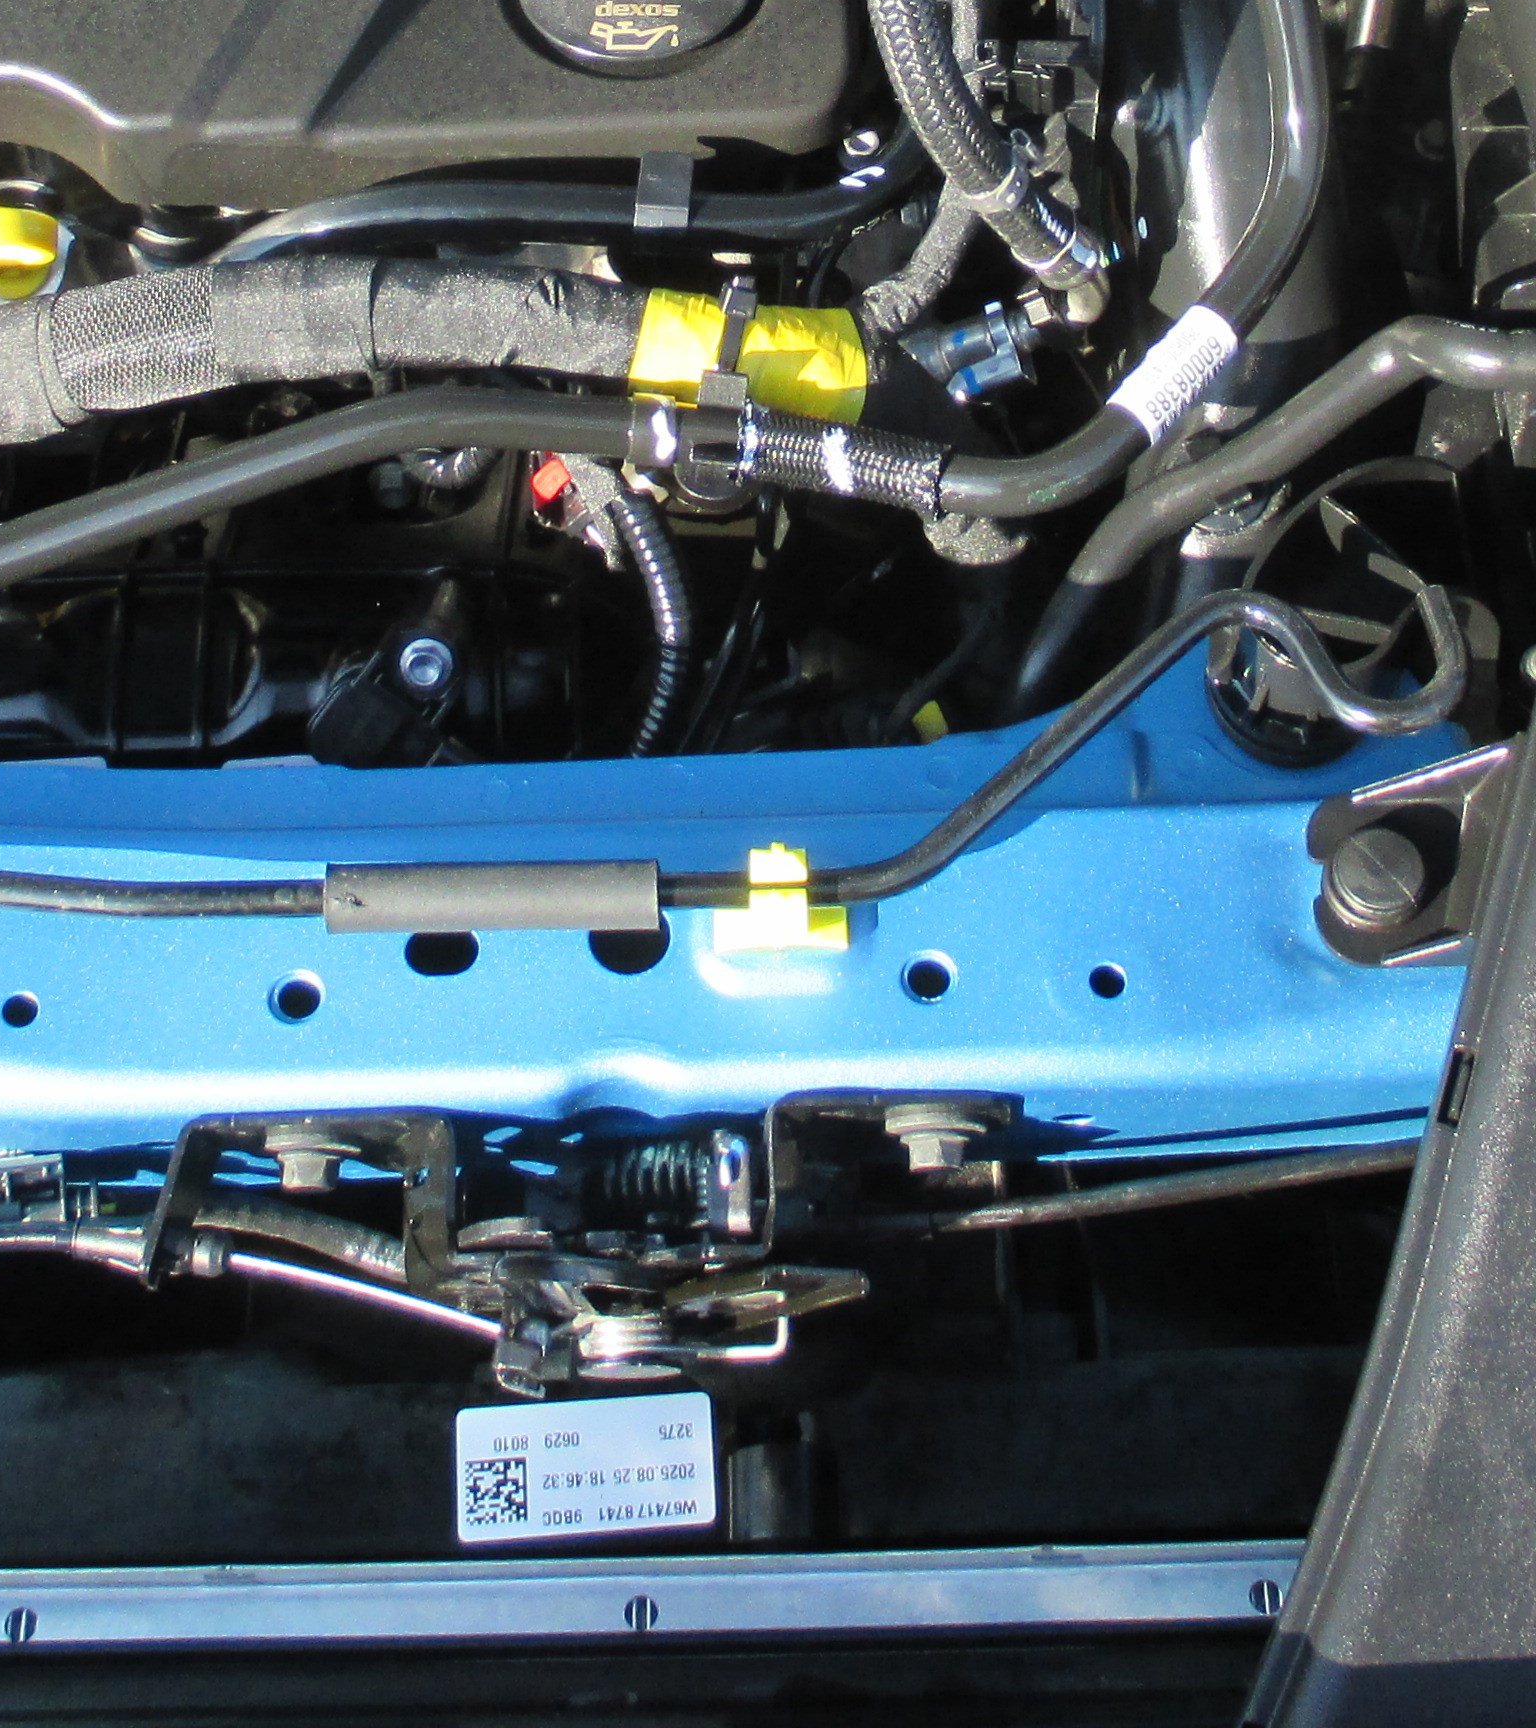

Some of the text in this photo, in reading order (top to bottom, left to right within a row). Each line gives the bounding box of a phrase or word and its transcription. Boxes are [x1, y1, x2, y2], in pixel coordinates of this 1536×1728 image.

[594, 0, 682, 17] dexos
[1146, 336, 1225, 422] 60008388
[493, 1422, 694, 1453] 3275 0629 8010
[542, 1463, 696, 1490] 2025.08.25 18:46:32
[598, 1506, 634, 1521] 8741
[637, 1499, 697, 1518] W67417
